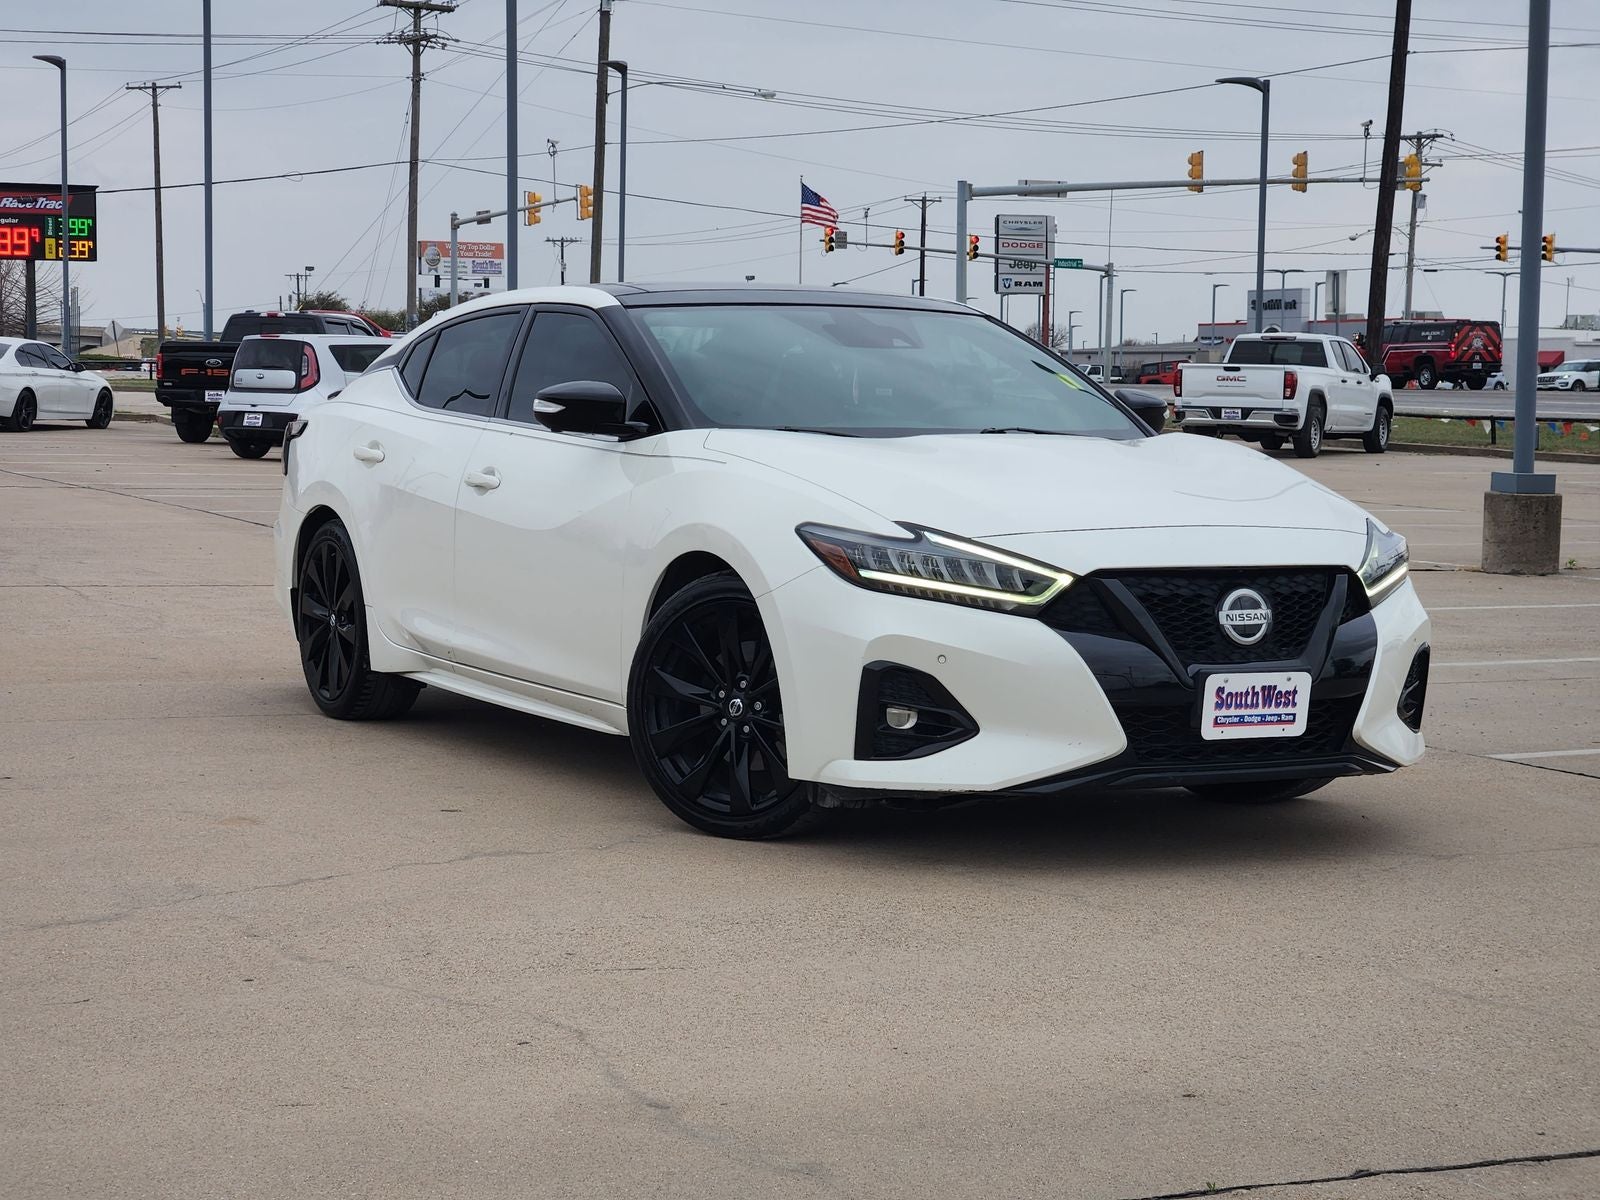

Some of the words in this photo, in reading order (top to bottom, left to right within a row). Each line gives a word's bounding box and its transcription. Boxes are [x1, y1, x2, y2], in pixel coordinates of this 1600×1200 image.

[1009, 259, 1037, 271] Jeep
[1225, 612, 1267, 622] NISSAN
[1214, 685, 1298, 711] SouthWest
[1217, 716, 1240, 725] Chrysler
[1244, 715, 1262, 723] Dodge
[1265, 714, 1278, 723] Jeep
[1281, 713, 1294, 721] Ram
